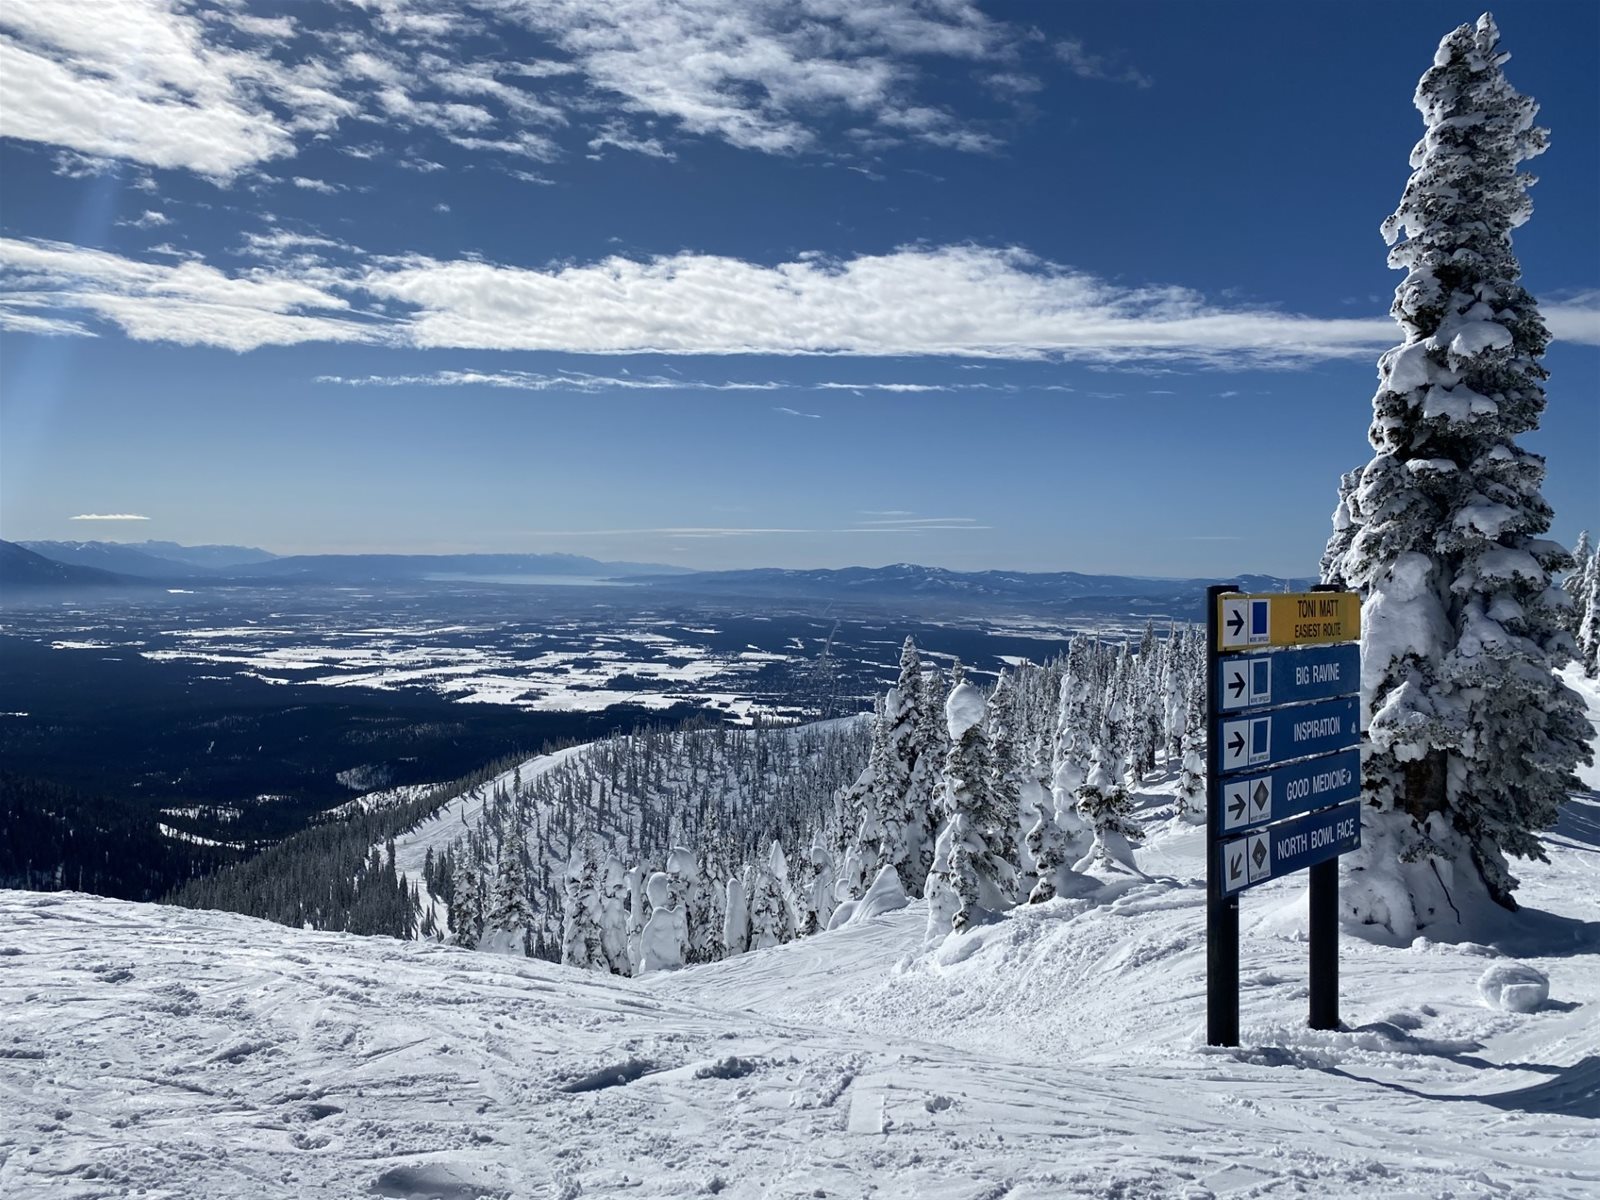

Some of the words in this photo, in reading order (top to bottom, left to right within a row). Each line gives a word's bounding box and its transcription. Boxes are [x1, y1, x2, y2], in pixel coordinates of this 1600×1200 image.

[1298, 600, 1316, 618] TONI
[1320, 600, 1339, 617] MATT
[1295, 623, 1320, 638] EASIEST
[1323, 622, 1341, 636] ROUTE
[1296, 665, 1309, 685] BIG
[1313, 663, 1340, 684] RAVINE
[1294, 716, 1340, 742] INSPIRATION
[1287, 778, 1309, 801] GOOD
[1313, 768, 1346, 793] MEDICINE
[1277, 833, 1307, 860] NORTH
[1311, 828, 1334, 849] BOWL
[1337, 818, 1354, 840] FACE
